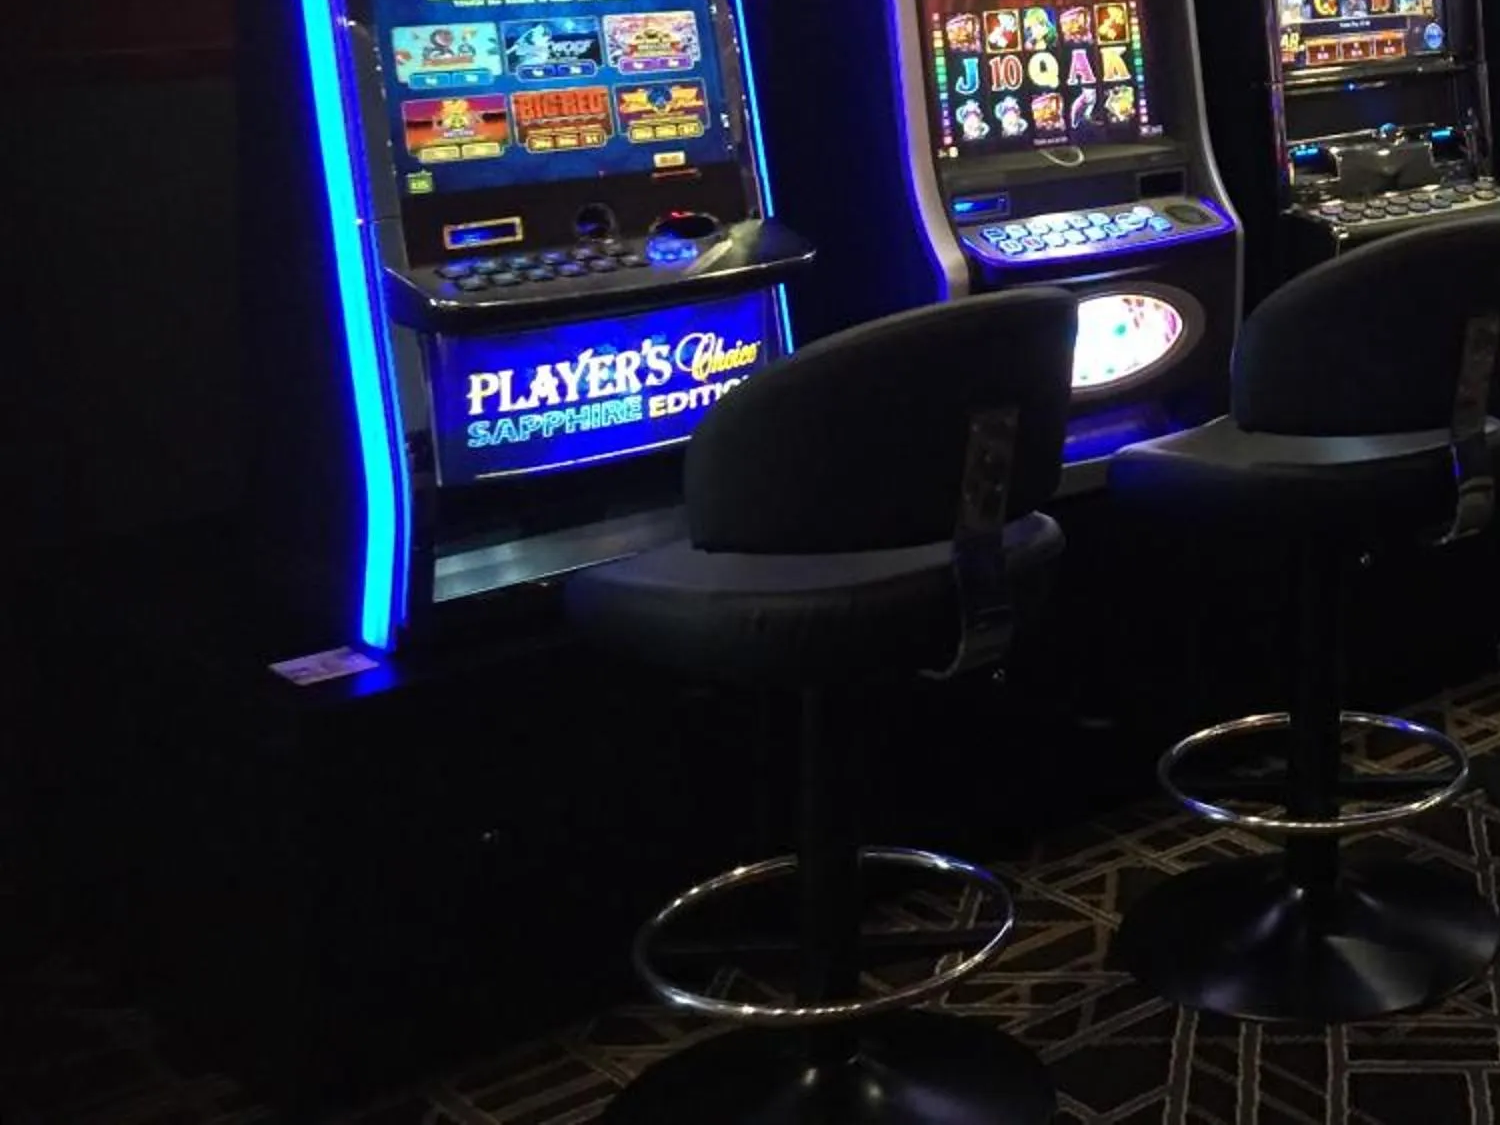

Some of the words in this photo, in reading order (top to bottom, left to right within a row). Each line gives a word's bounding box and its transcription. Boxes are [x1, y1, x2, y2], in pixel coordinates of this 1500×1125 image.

[989, 55, 1022, 91] 10
[1028, 51, 1059, 89] Q
[1067, 48, 1096, 85] A
[467, 339, 673, 415] PLAYER'S
[467, 394, 642, 447] SAPPHIRE
[649, 375, 749, 418] EDITI
